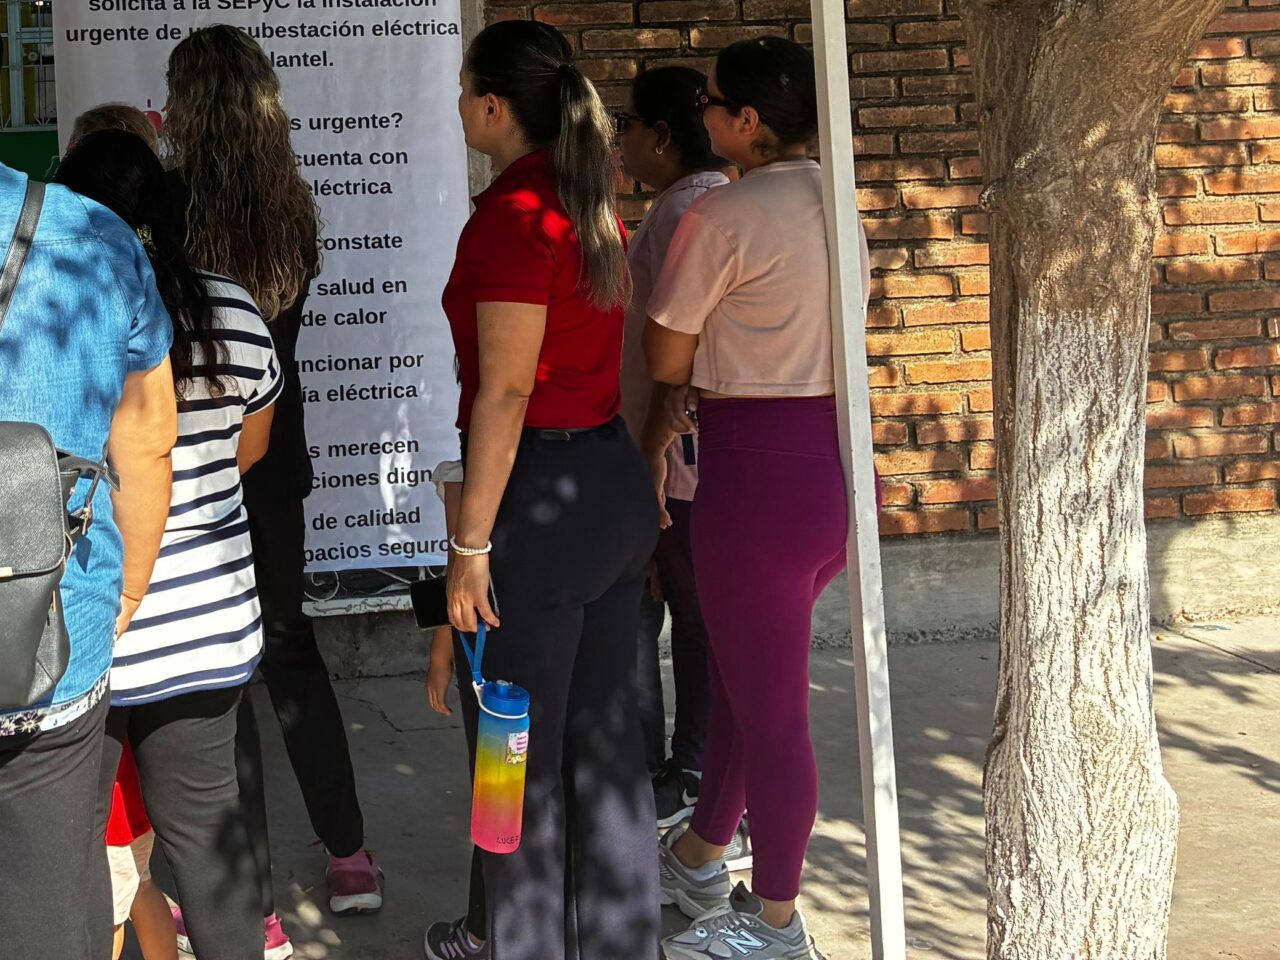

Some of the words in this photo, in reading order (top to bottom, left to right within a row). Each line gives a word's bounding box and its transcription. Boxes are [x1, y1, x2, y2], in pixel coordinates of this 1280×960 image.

[66, 25, 149, 45] urgente
[156, 24, 182, 40] de
[372, 19, 459, 36] eléctrica
[270, 51, 334, 67] lantel.
[309, 112, 403, 133] urgente?
[369, 151, 408, 164] con
[317, 277, 374, 296] salud
[382, 279, 407, 293] en
[301, 310, 327, 326] de
[334, 308, 387, 326] calor
[389, 354, 424, 373] por
[326, 382, 418, 402] eléctrica
[328, 439, 419, 458] merecen
[387, 467, 433, 487] dign
[312, 513, 338, 530] de
[344, 506, 421, 528] calidad
